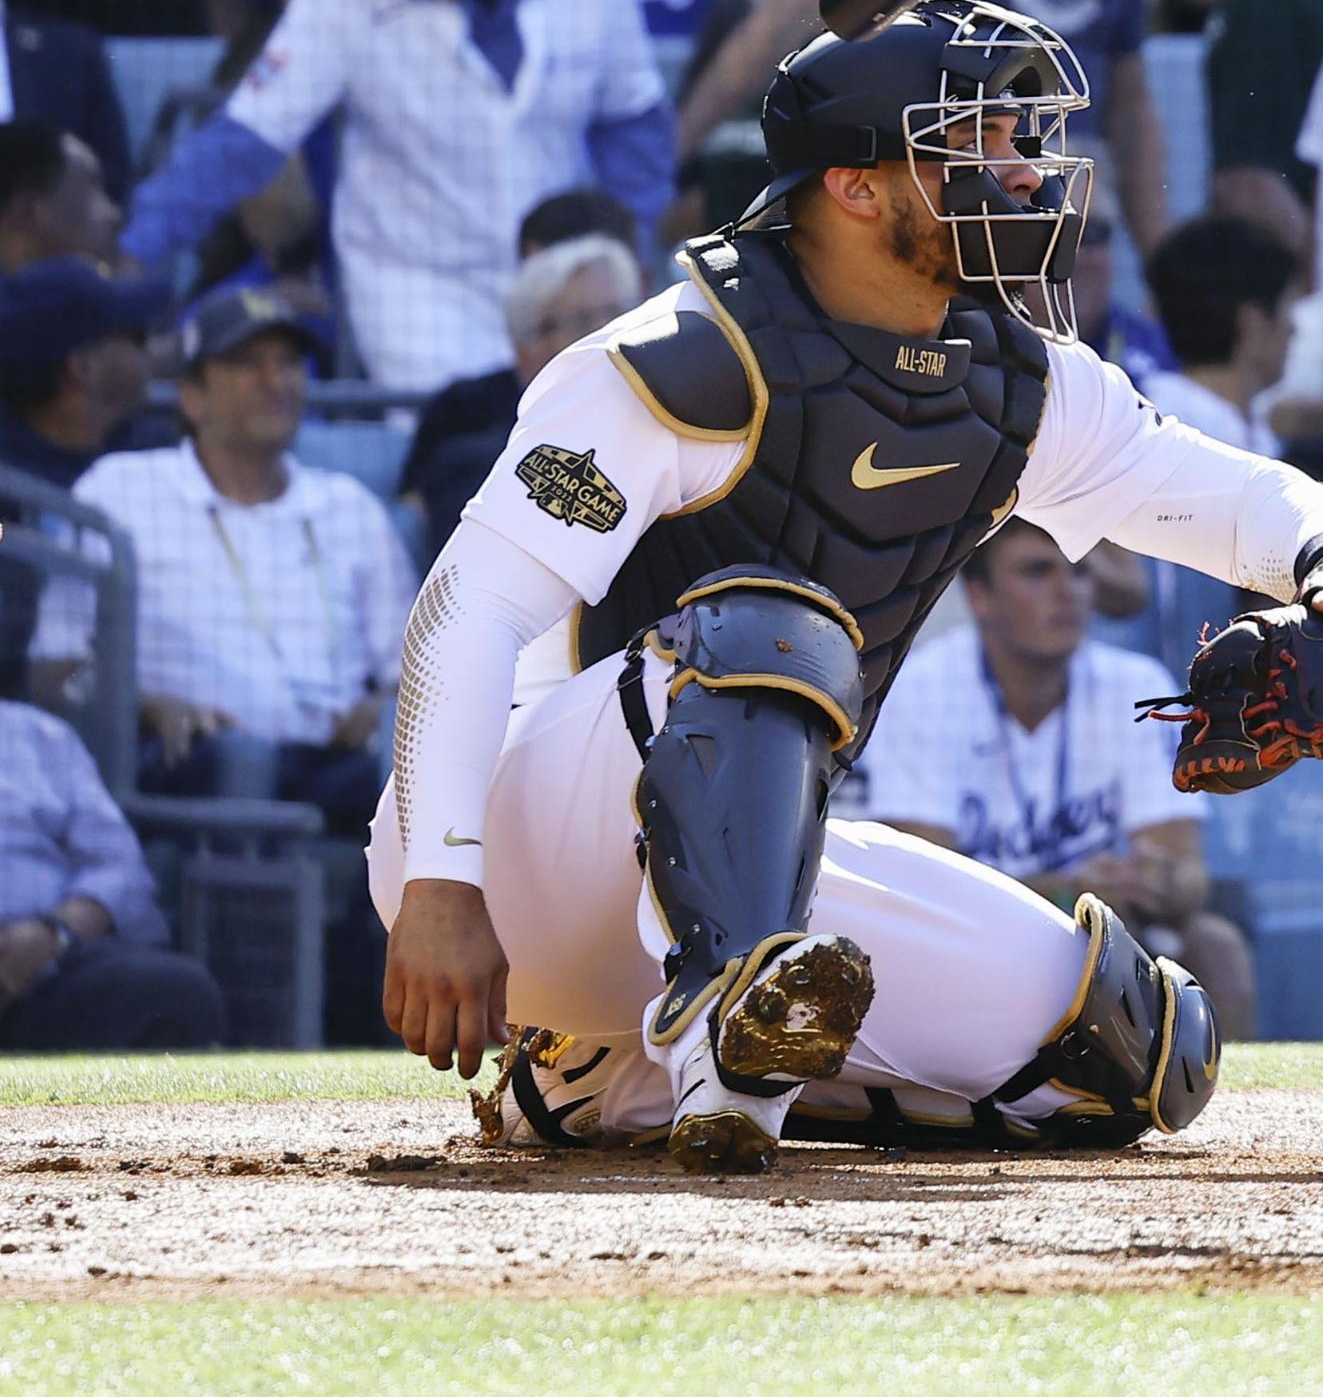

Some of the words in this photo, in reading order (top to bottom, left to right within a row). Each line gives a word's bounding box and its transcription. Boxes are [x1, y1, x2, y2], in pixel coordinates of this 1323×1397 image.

[895, 345, 947, 378] ALL-STAR
[551, 485, 572, 502] 2022
[577, 485, 621, 522] GAME
[1156, 514, 1194, 522] DRI-FIT
